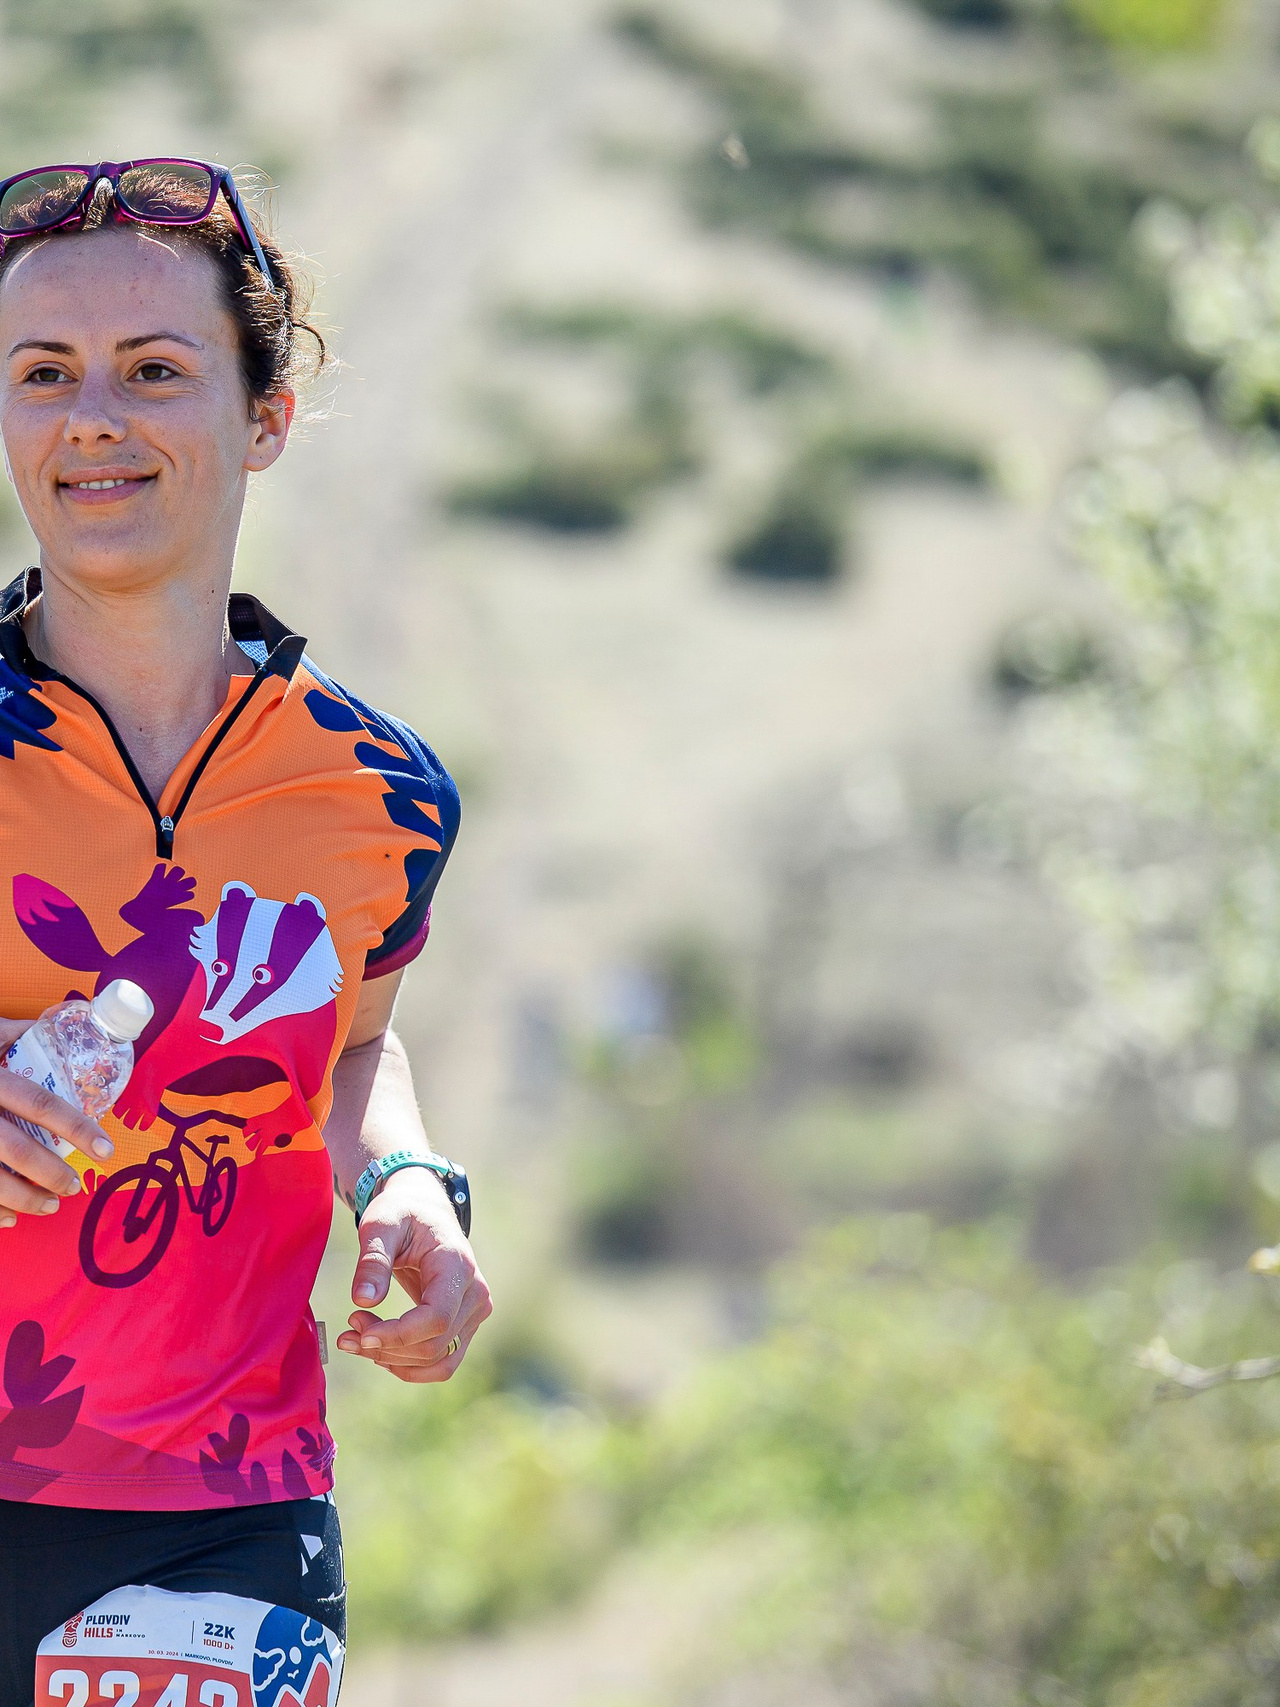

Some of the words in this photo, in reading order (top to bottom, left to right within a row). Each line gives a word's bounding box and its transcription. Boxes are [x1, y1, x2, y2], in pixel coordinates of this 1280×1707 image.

[86, 1615, 130, 1625] PLOVDIV
[84, 1627, 113, 1638] HILLS
[204, 1622, 235, 1640] 22K
[203, 1639, 222, 1648] 1000
[212, 1657, 234, 1666] PLOVDIV
